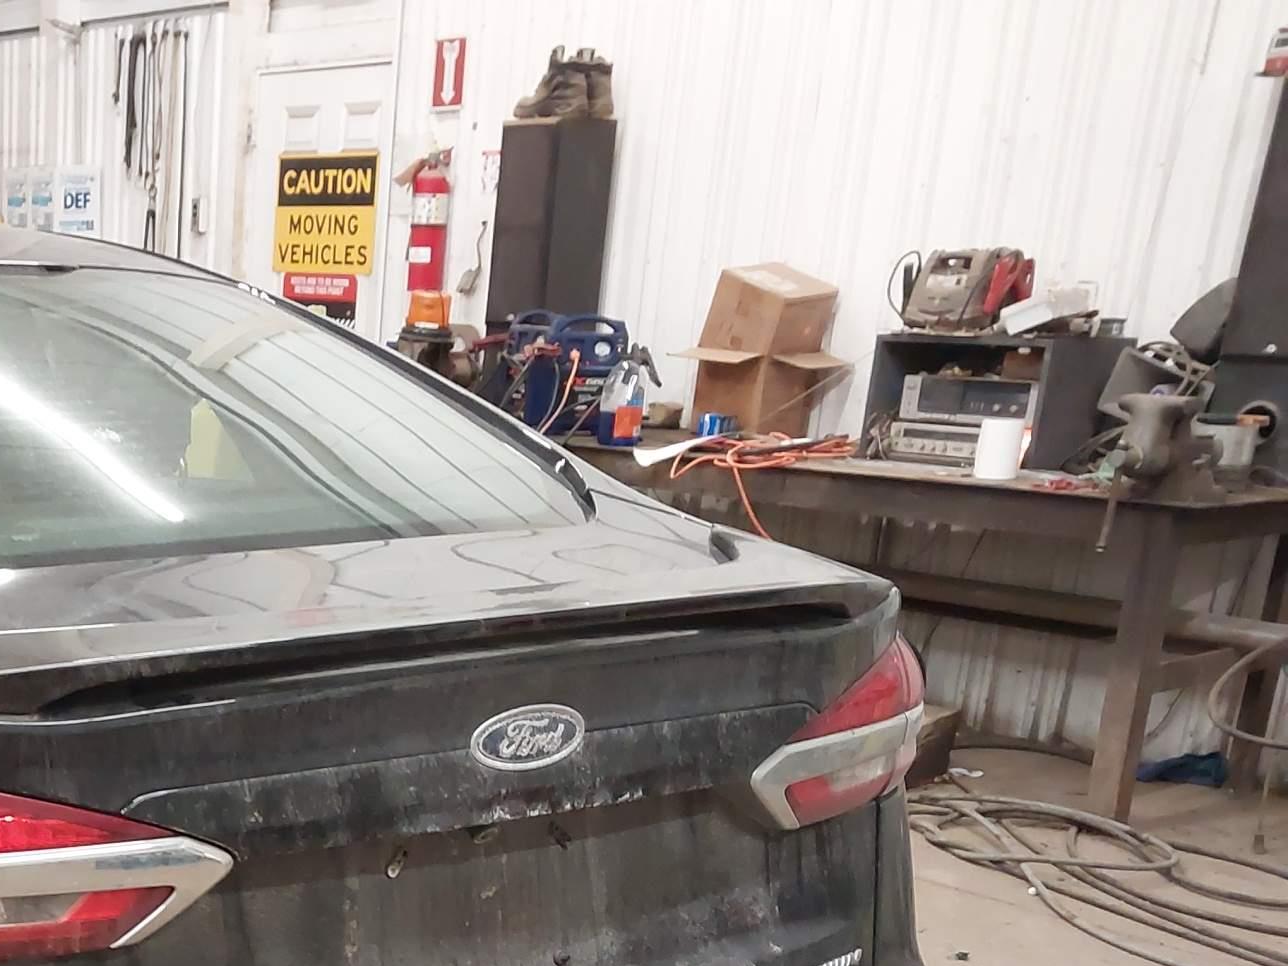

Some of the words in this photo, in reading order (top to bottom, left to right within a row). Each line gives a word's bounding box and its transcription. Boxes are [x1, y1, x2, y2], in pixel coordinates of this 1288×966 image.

[283, 168, 373, 194] CAUTION
[64, 192, 91, 209] DEF
[289, 214, 359, 235] MOVING
[278, 243, 368, 265] VEHICLES
[498, 718, 565, 758] Ford
